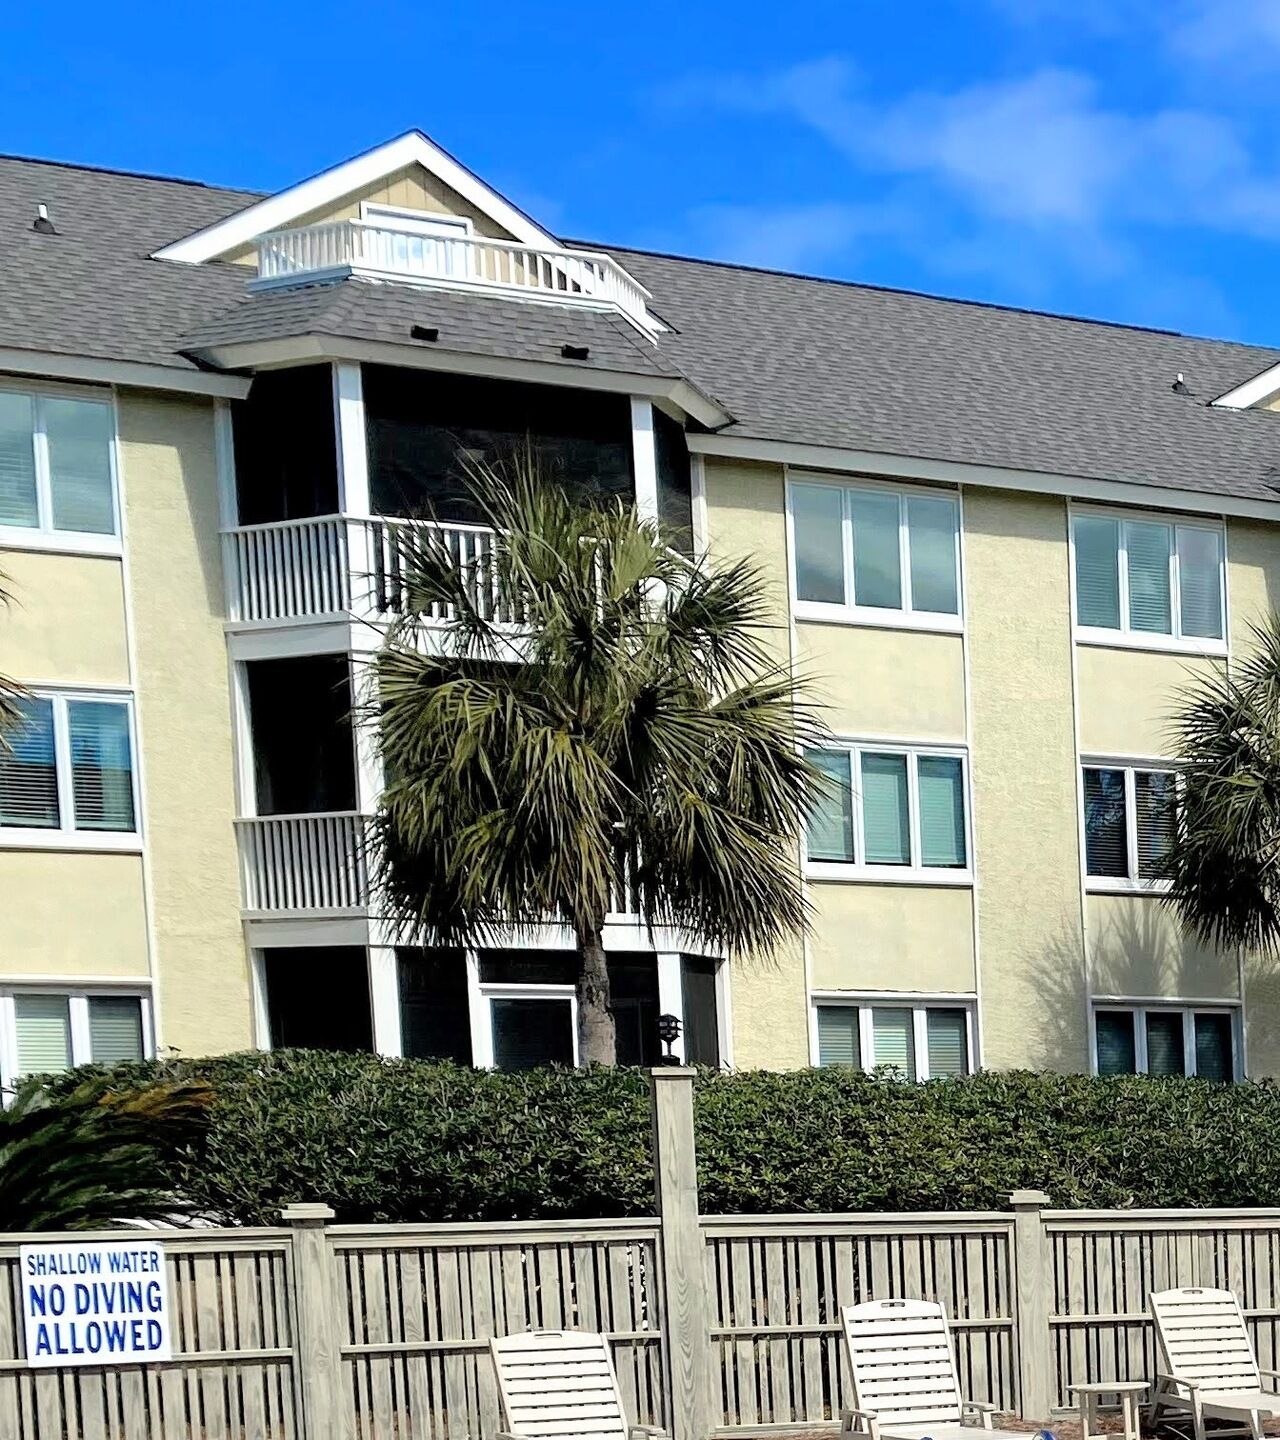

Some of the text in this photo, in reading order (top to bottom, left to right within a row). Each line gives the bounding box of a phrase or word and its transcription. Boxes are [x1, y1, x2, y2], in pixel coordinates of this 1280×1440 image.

[27, 1251, 159, 1276] SHALLOW WATER
[29, 1280, 162, 1317] NO DIVING
[35, 1319, 163, 1356] ALLOWED
